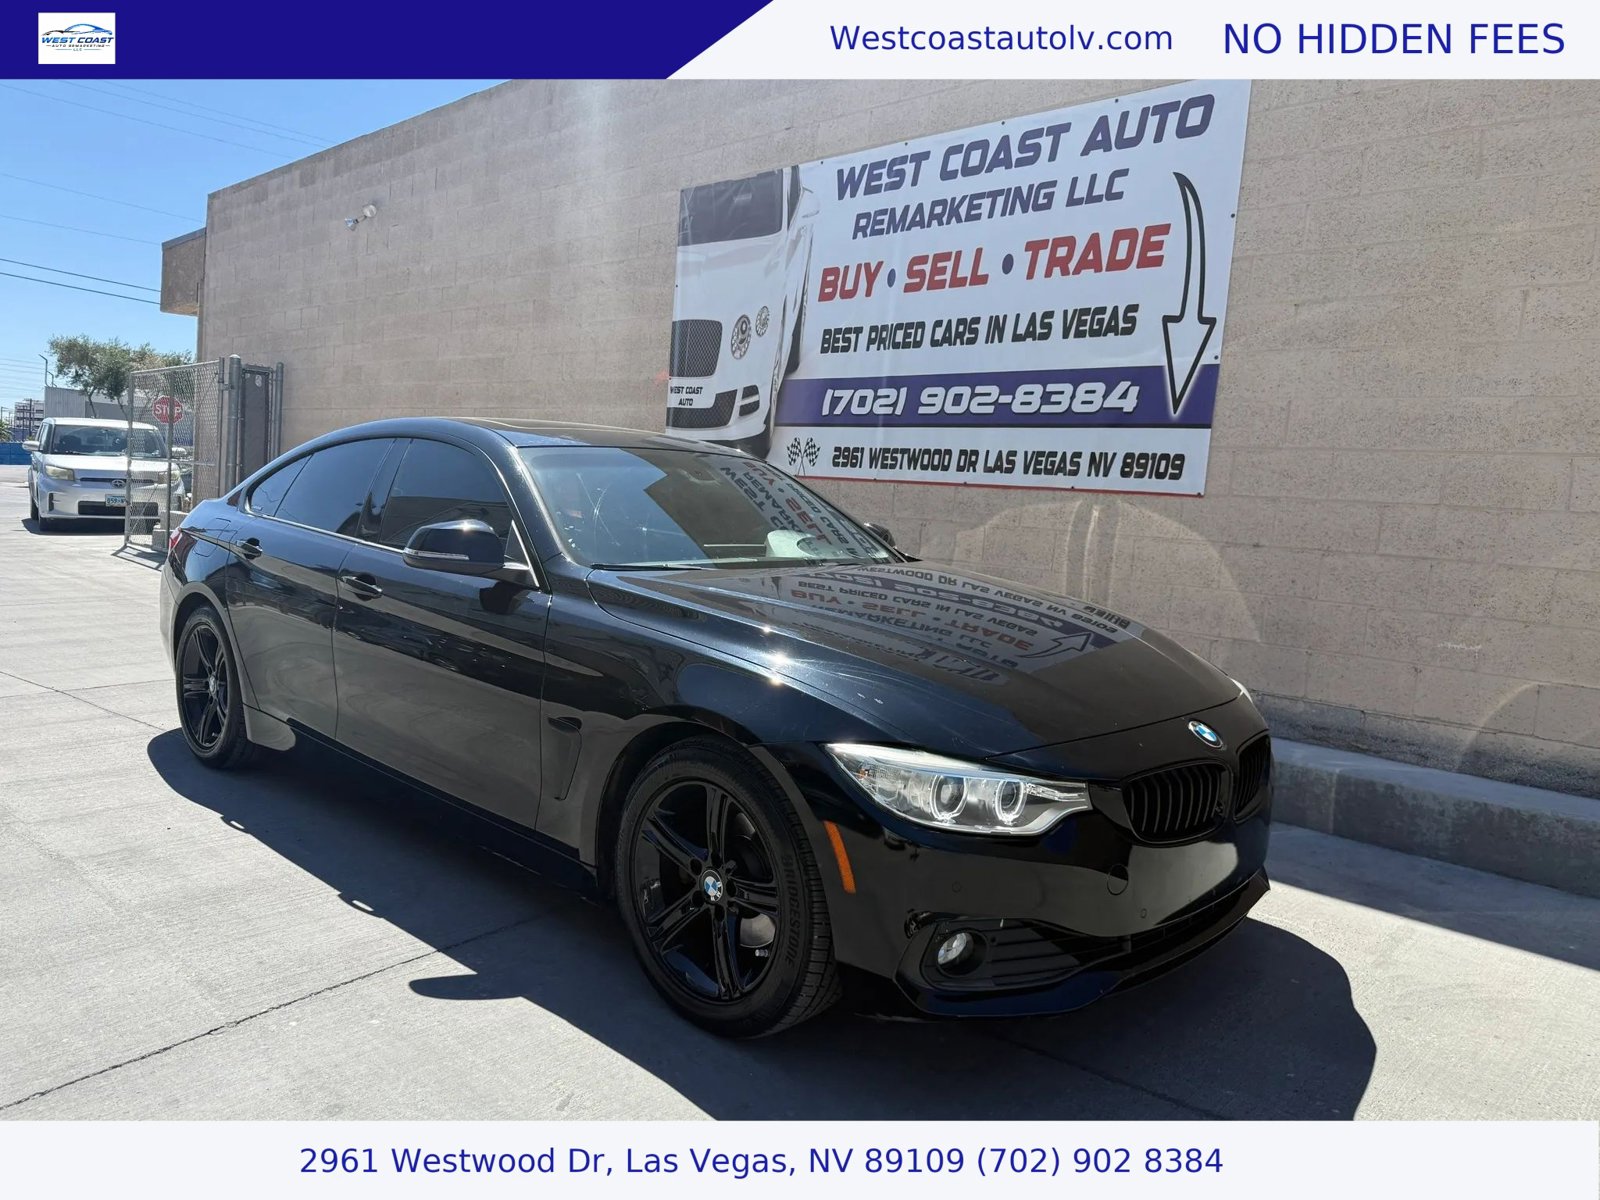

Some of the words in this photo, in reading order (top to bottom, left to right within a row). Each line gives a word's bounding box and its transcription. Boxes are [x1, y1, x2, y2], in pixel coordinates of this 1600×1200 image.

[837, 151, 931, 201] WEST
[939, 122, 1072, 181] COAST
[1080, 94, 1216, 157] AUTO
[852, 180, 1057, 240] REMARKETING
[1065, 168, 1130, 208] LLC
[818, 260, 884, 302] BUY
[904, 247, 989, 293] SELL
[1024, 223, 1172, 280] TRADE
[820, 325, 864, 354] BEST
[866, 321, 927, 351] PRICED
[930, 316, 981, 348] CARS
[985, 314, 1008, 344] IN
[1011, 310, 1055, 342] LAS
[1062, 304, 1139, 340] VEGAS
[155, 403, 181, 417] STP
[678, 398, 694, 406] AUTO
[685, 386, 704, 394] COAST
[822, 387, 908, 416] (702)
[917, 380, 1140, 415] 902-8384
[832, 446, 865, 468] 2961
[868, 447, 952, 471] WESTWOOD
[956, 449, 980, 473] DR
[983, 450, 1017, 474] LAS
[1023, 451, 1082, 476] VEGAS
[1087, 452, 1117, 477] NV
[1120, 452, 1186, 480] 89109
[781, 854, 801, 967] BRIDGESTONE
